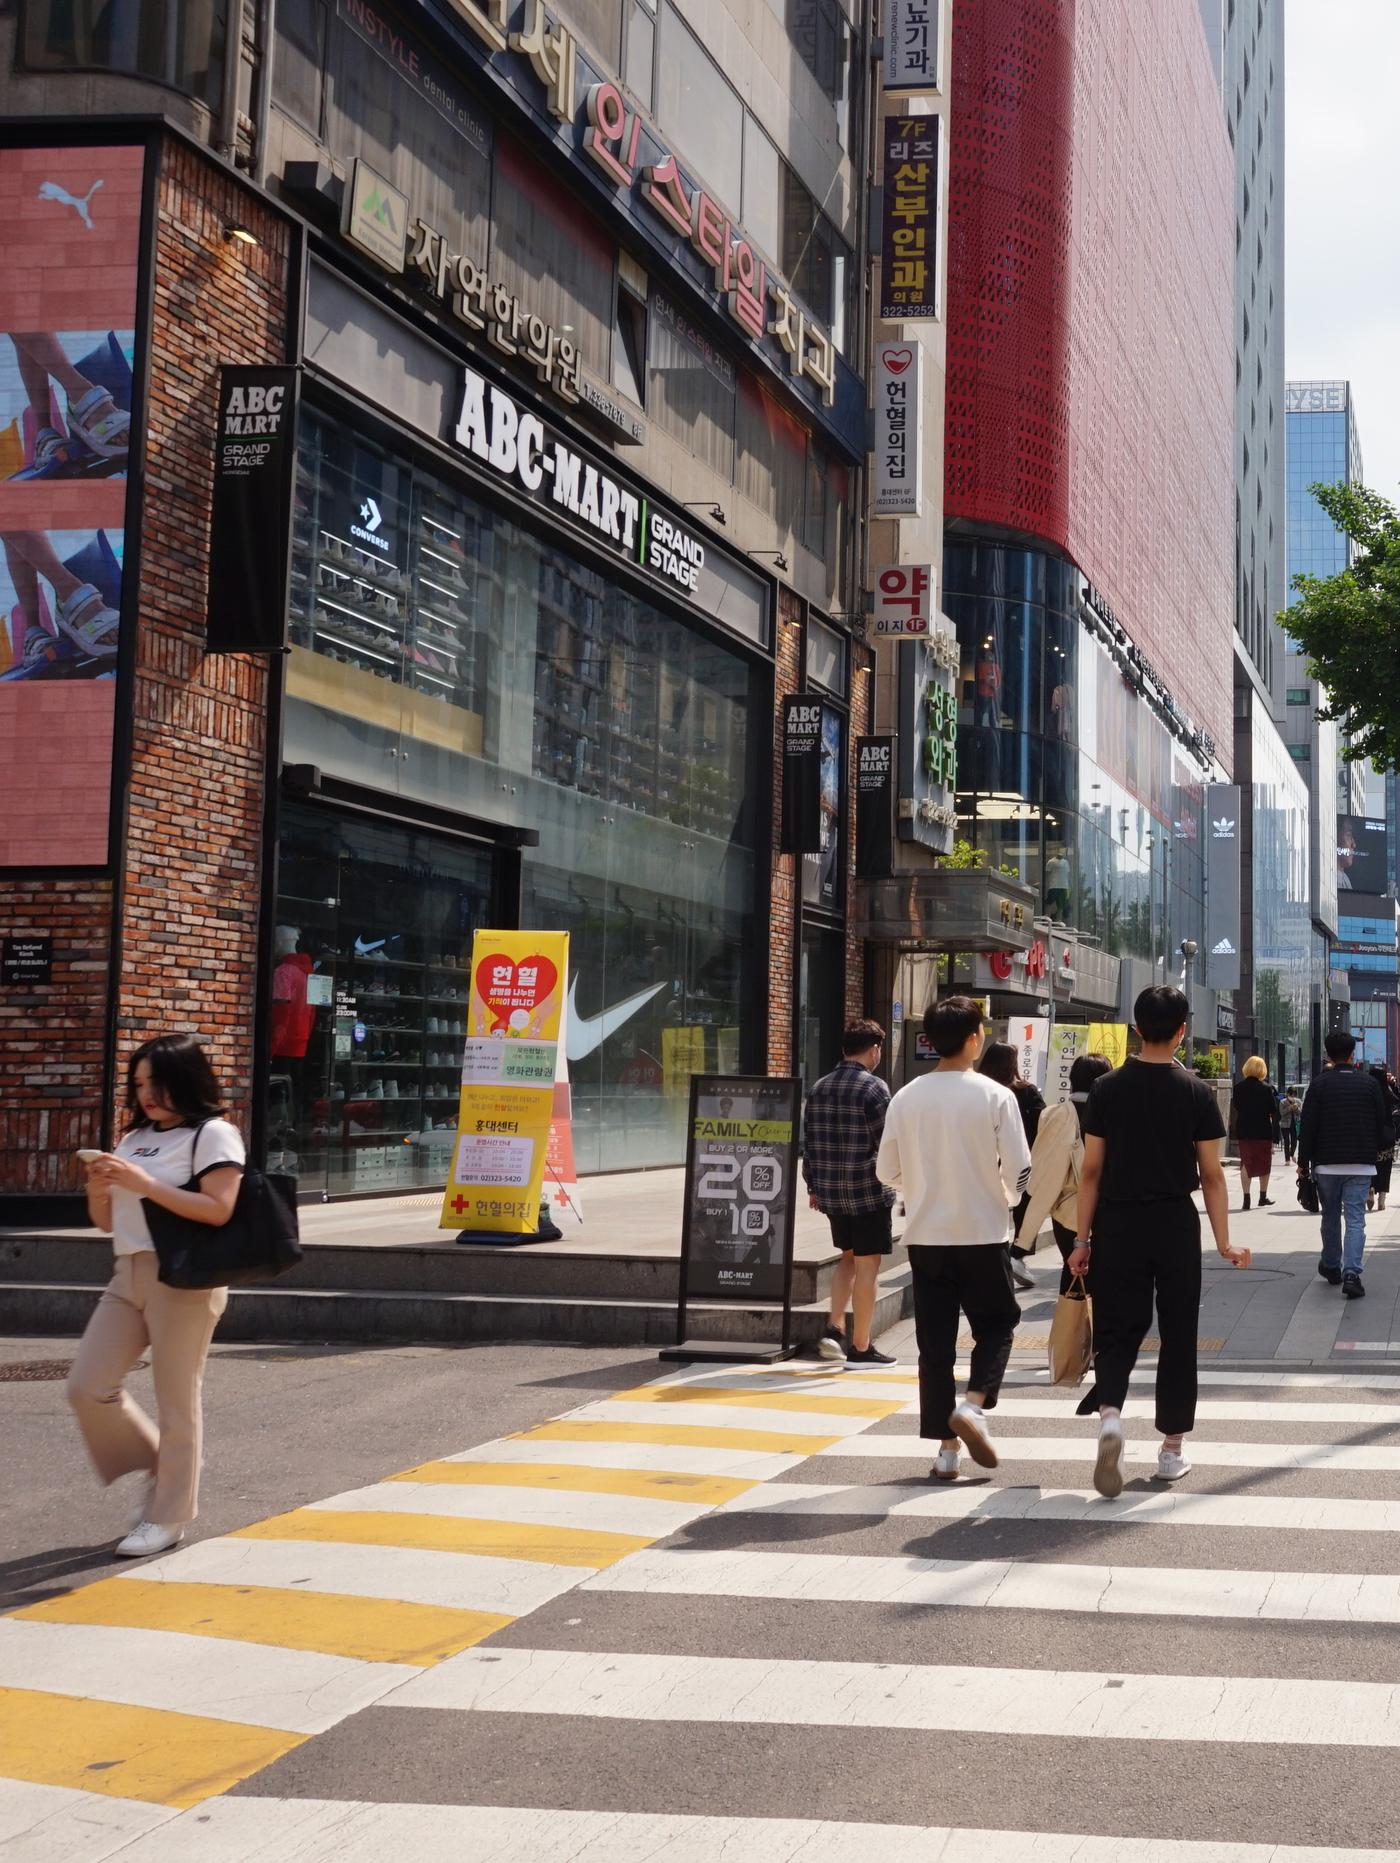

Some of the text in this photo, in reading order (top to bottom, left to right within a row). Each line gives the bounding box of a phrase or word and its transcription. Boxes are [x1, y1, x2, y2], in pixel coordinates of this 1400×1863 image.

[424, 73, 456, 113] dental
[458, 108, 485, 143] clinic
[898, 120, 927, 137] 7F
[890, 141, 934, 160] 리즈
[890, 162, 930, 290] 산부인과
[583, 82, 768, 346] 인스타일
[769, 285, 836, 408] 치과
[407, 217, 584, 405] 자연한의원
[882, 304, 935, 317] 322-5252
[226, 385, 286, 414] ABC
[1286, 387, 1341, 410] YSE
[224, 414, 281, 435] MART
[885, 380, 907, 479] 헌혈의집
[223, 443, 271, 456] GRAND
[455, 367, 640, 550] ABC-MART
[223, 455, 265, 467] STAGE
[350, 524, 389, 551] CONVERSE
[650, 513, 706, 570] GRAND
[650, 542, 700, 594] STAGE
[879, 567, 928, 616] 약
[876, 618, 925, 634] 이지 1F
[787, 706, 821, 723] ABC
[787, 723, 820, 735] MART
[786, 738, 816, 746] GRAND
[786, 745, 813, 753] STAGE
[860, 746, 890, 761] ABC
[859, 761, 890, 773] MART
[859, 775, 885, 783] GRAND
[1212, 946, 1236, 954] adidas
[492, 965, 538, 986] 헌혈
[475, 1119, 519, 1133] 홍대센터
[694, 1120, 758, 1138] FAMILY
[709, 1144, 726, 1152] BUY
[750, 1146, 774, 1154] MORE
[697, 1154, 783, 1200] 20
[753, 1181, 770, 1189] OFF
[475, 1199, 532, 1218] 헌혈의집
[706, 1207, 723, 1216] BUY
[729, 1202, 770, 1236] 10
